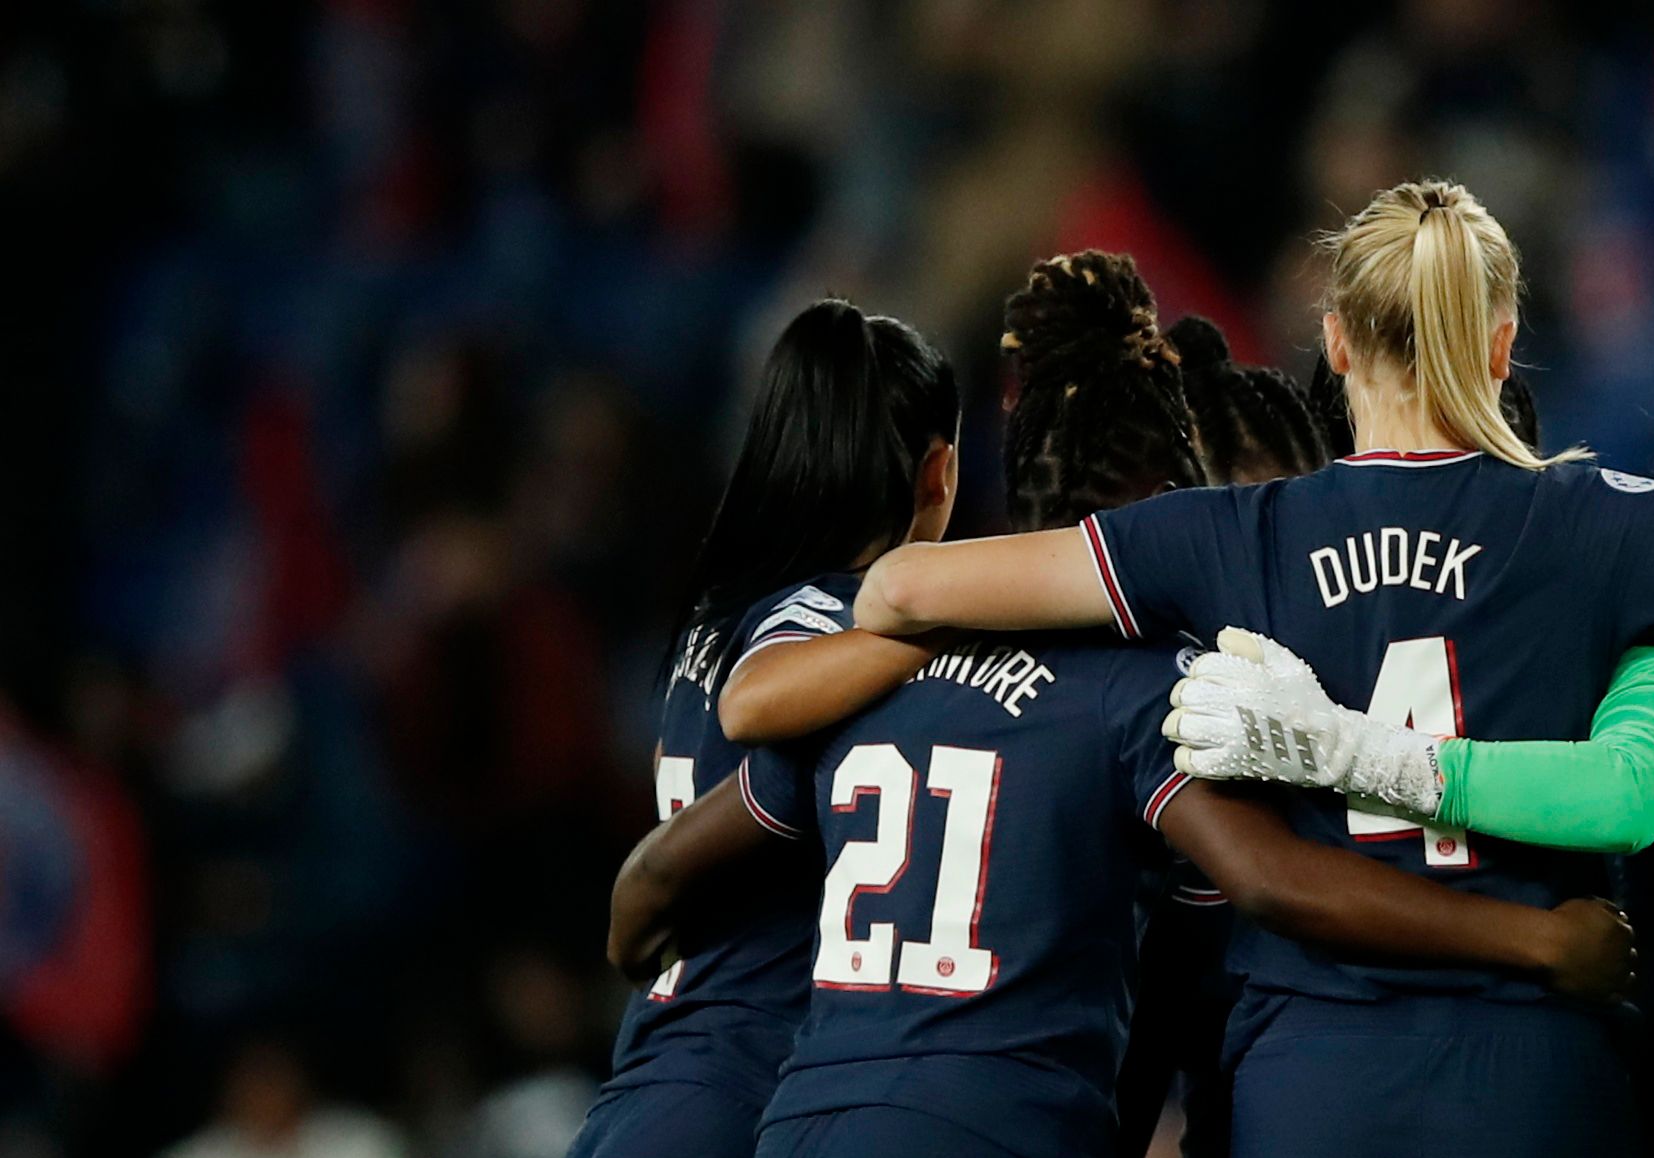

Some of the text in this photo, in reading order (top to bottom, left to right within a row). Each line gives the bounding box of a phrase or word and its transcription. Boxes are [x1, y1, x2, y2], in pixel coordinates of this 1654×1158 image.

[1309, 527, 1482, 608] DUDEK
[1347, 636, 1478, 868] 4
[812, 743, 1003, 998] 21
